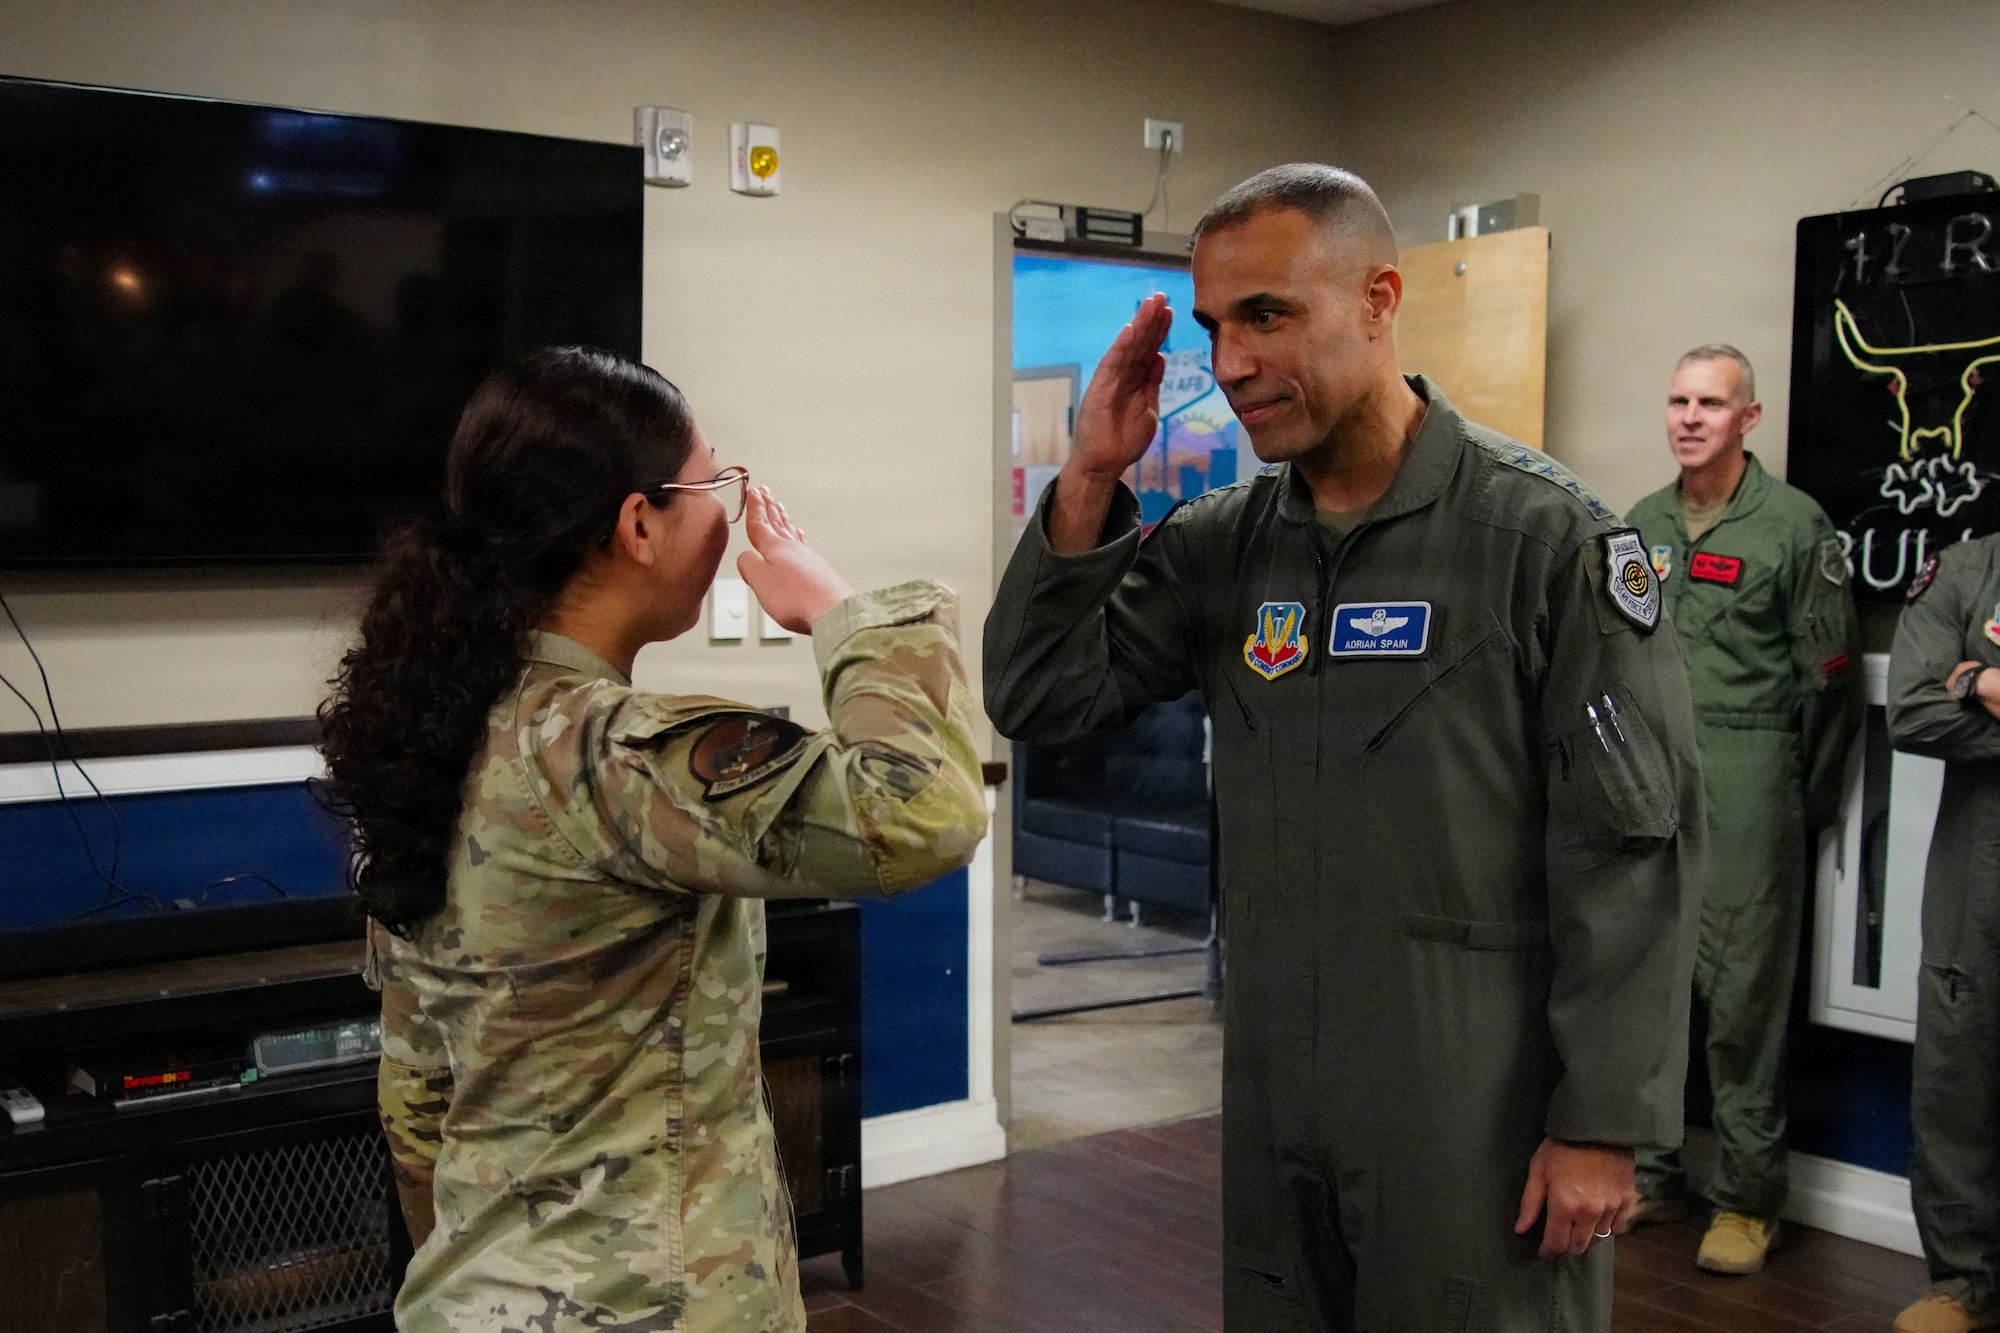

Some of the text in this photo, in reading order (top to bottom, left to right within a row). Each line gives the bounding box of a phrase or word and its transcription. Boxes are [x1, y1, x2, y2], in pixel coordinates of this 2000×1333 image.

[1613, 540, 1638, 554] GRADUATE
[1344, 638, 1409, 650] ADRIAN SPAIN
[1254, 657, 1274, 676] COMBAT
[1275, 651, 1303, 672] COMMAND
